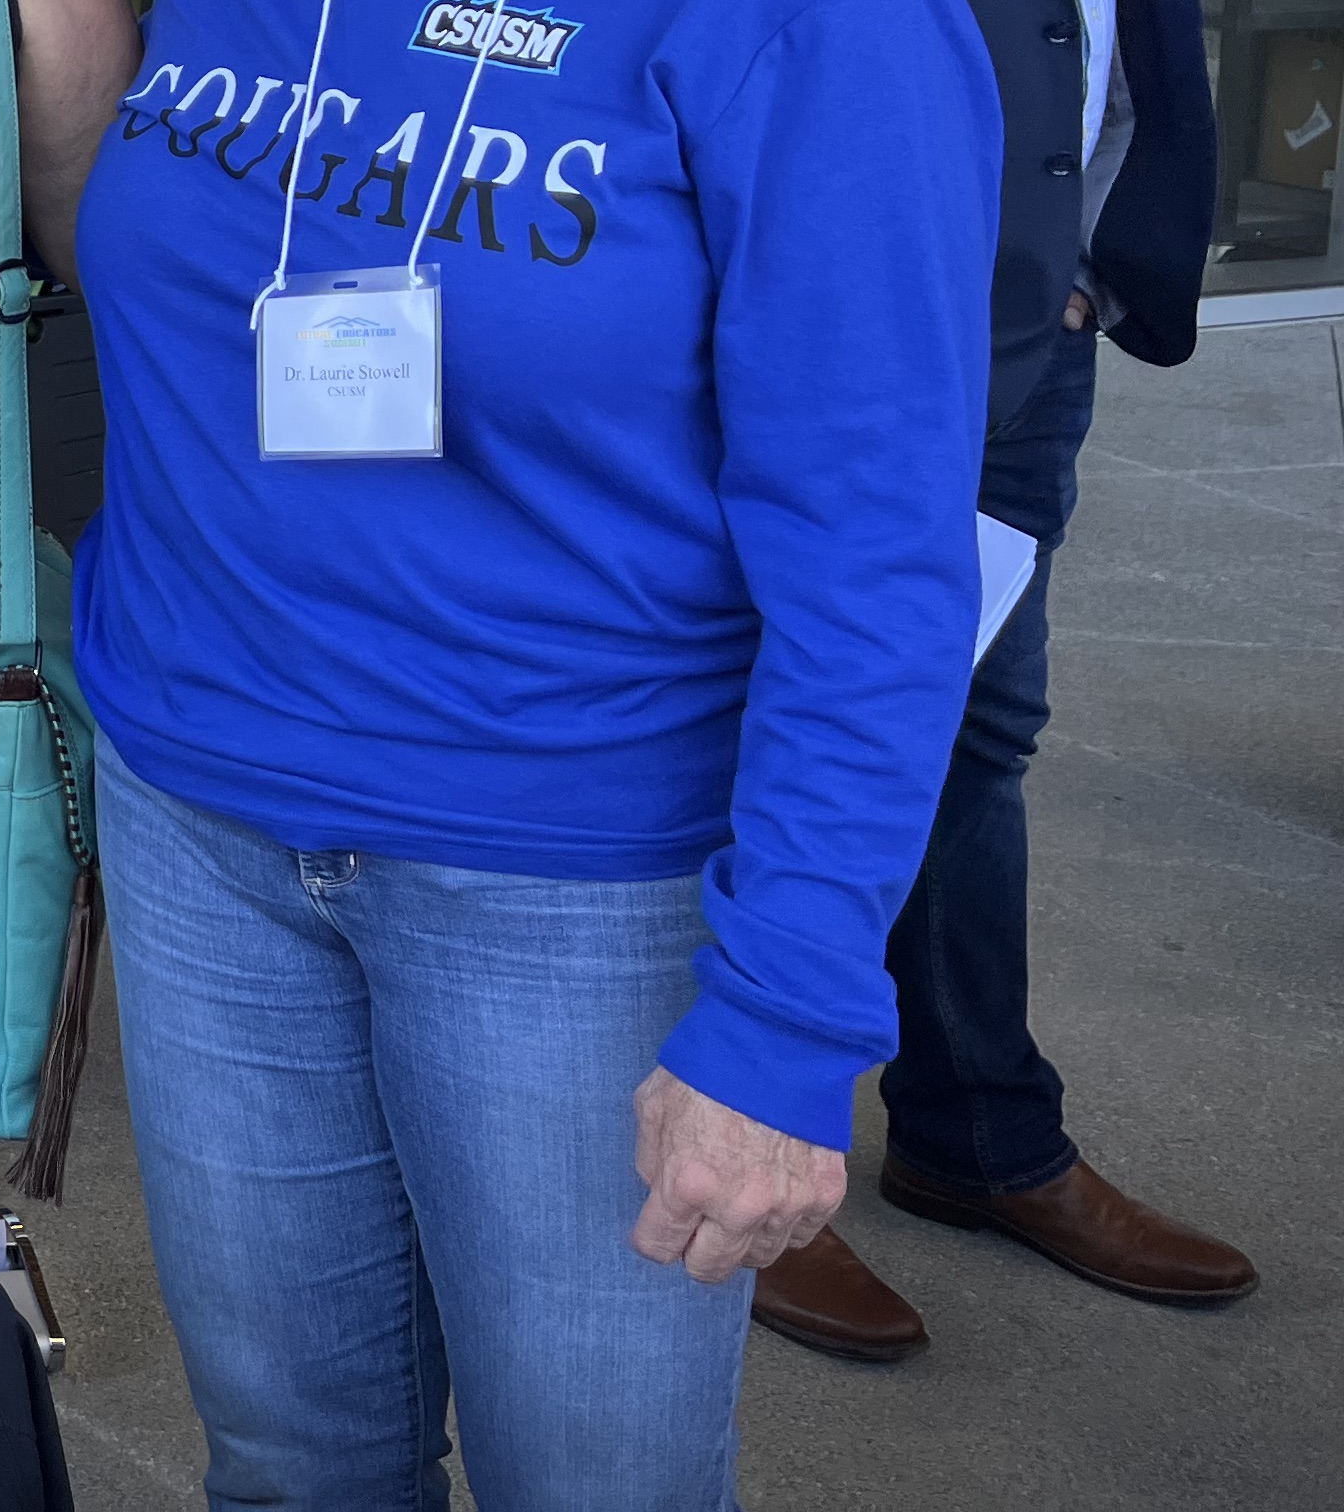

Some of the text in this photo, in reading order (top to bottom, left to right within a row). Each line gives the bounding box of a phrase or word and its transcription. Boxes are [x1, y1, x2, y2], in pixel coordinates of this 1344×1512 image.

[424, 3, 567, 64] CSUSM
[120, 63, 607, 266] COUGARS
[336, 327, 397, 339] EDUCATORS
[284, 363, 410, 382] Dr. Laurie Stowell
